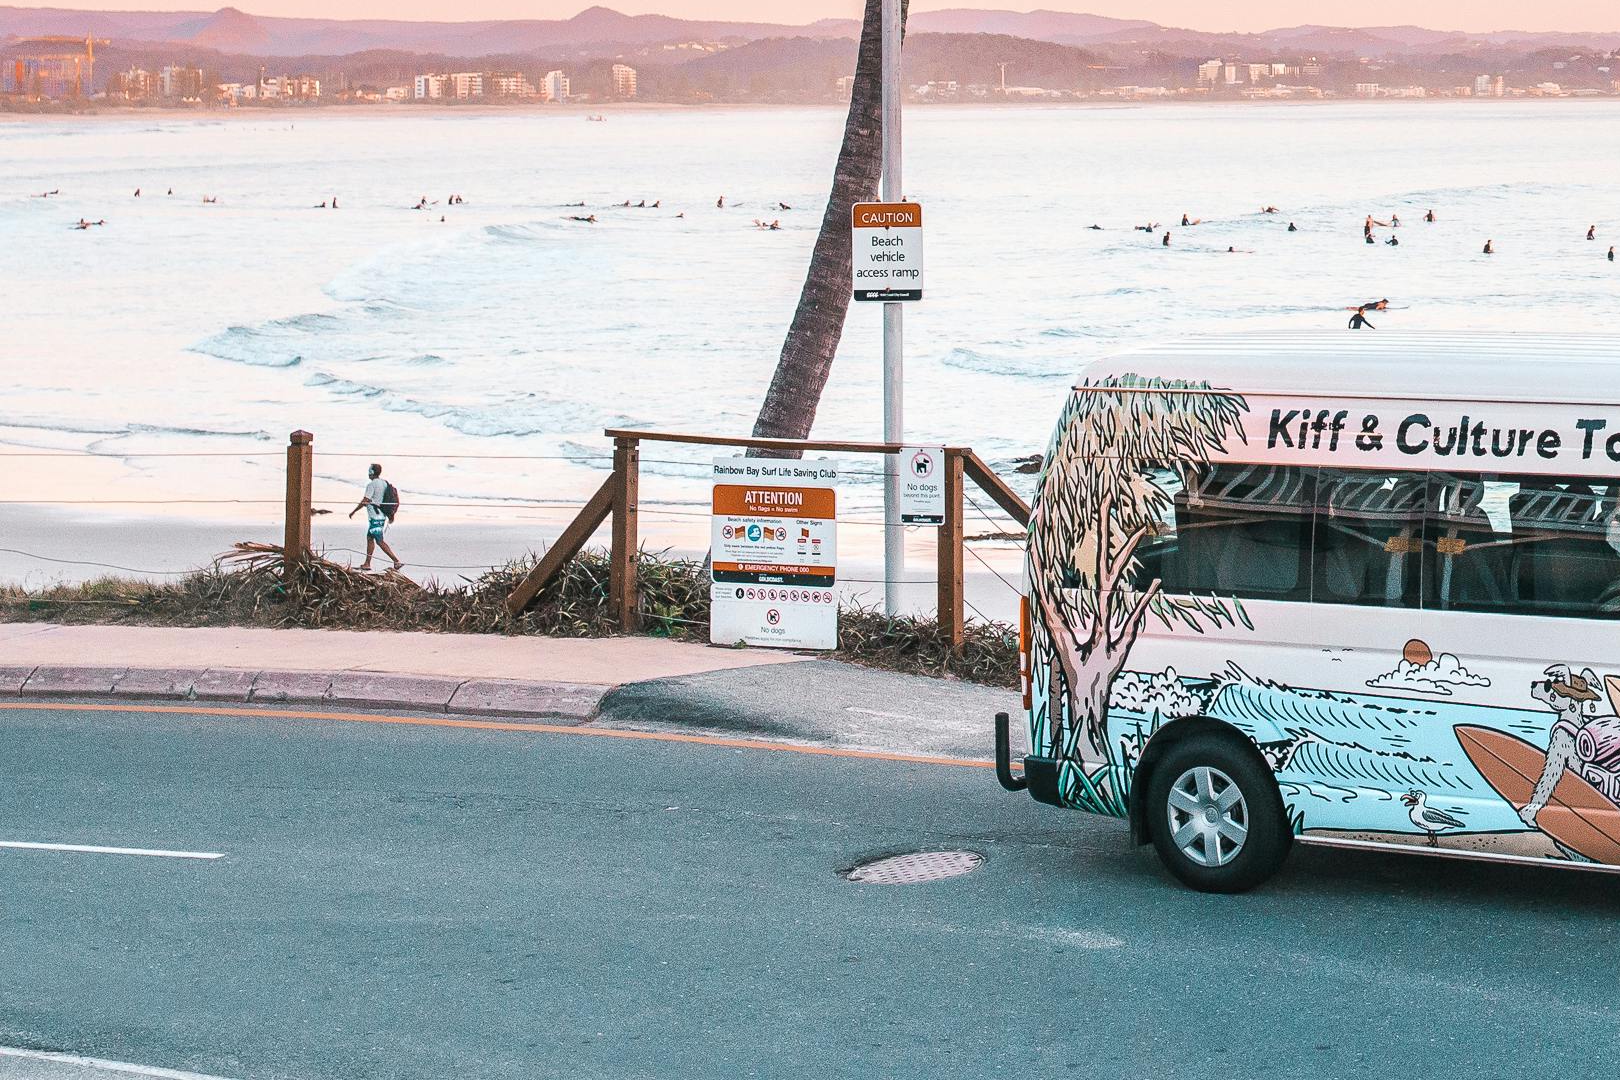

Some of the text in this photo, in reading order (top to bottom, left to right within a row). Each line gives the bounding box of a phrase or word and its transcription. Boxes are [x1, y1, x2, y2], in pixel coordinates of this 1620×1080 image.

[861, 212, 913, 224] CAUTION
[871, 235, 903, 247] Beach
[870, 251, 905, 262] vehicle
[856, 268, 919, 280] access ramp
[1267, 408, 1348, 452] Kiff
[1355, 414, 1384, 452] &
[1396, 413, 1562, 459] Culture
[713, 465, 837, 480] Rainbow Bay Surf Life Saving Club
[907, 483, 938, 493] No dogs
[744, 490, 803, 506] ATTENTION
[770, 626, 786, 635] dogs
